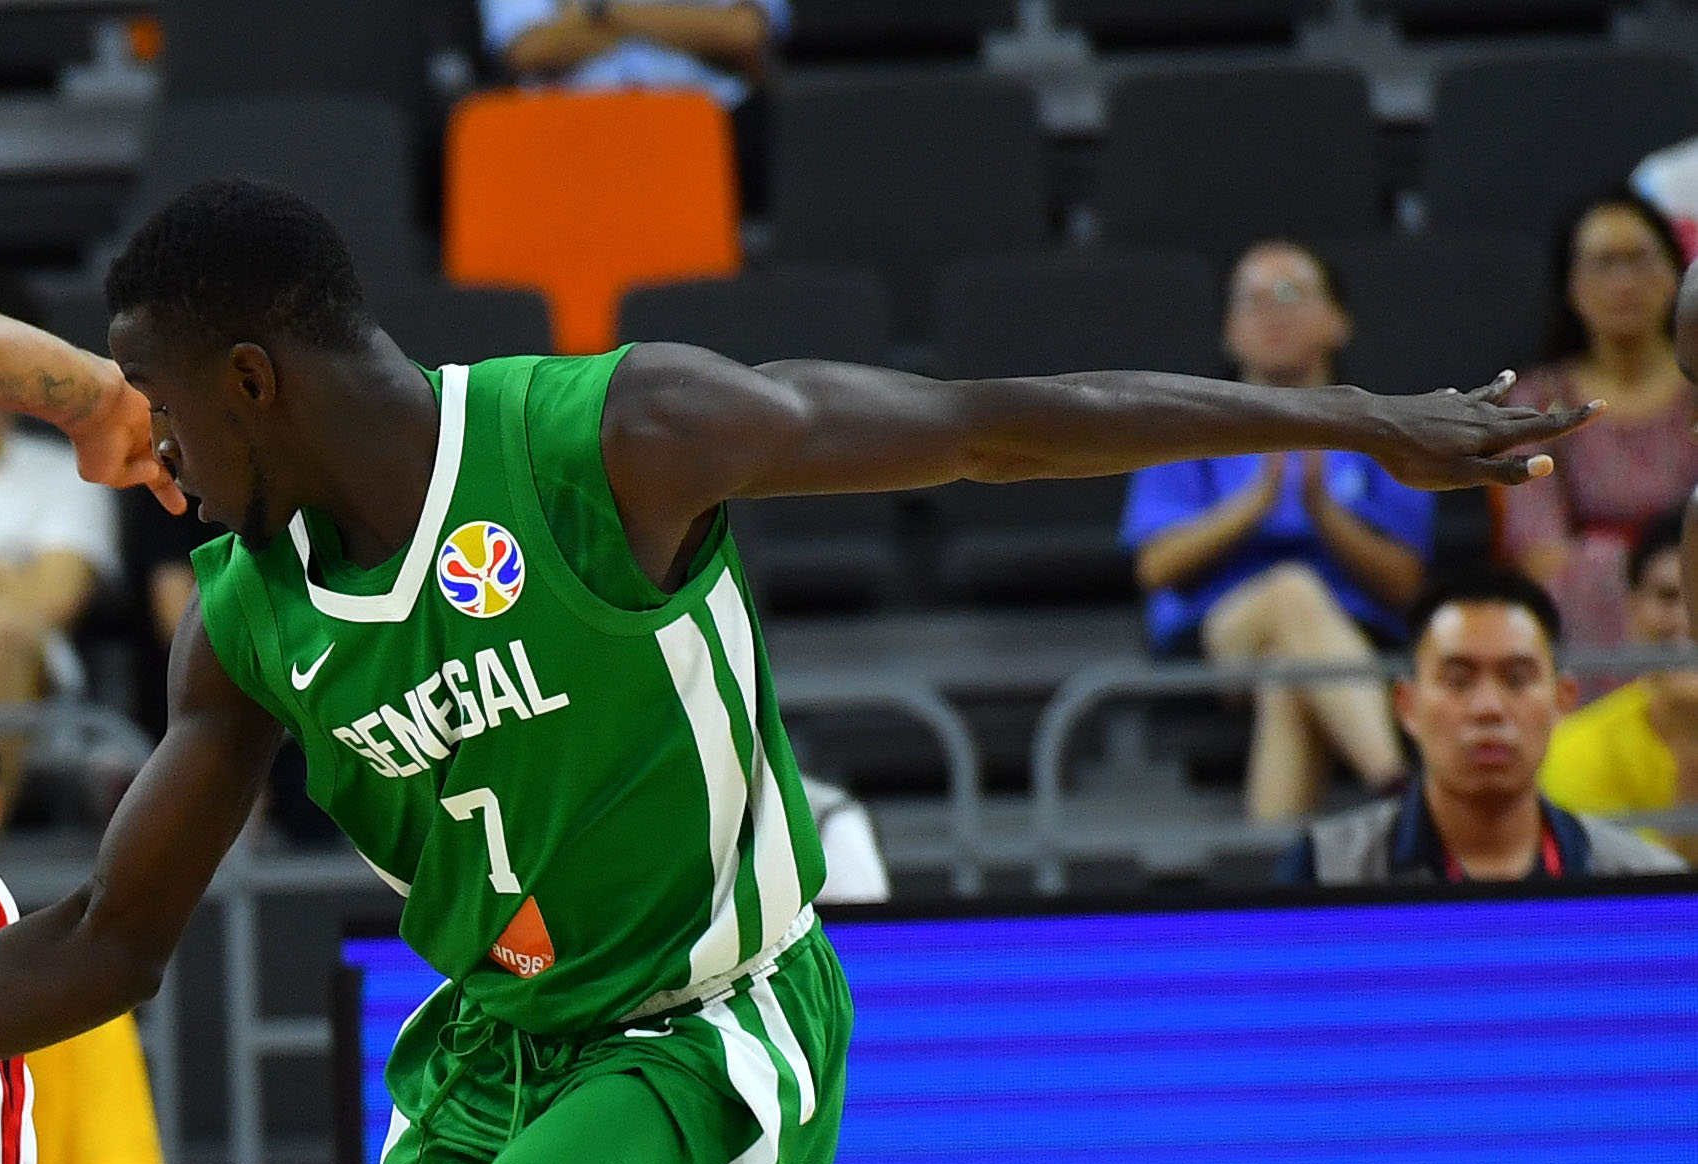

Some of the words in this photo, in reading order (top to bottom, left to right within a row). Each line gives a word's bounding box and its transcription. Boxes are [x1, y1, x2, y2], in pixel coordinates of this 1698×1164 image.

[331, 639, 570, 778] SENEGAL
[440, 787, 522, 894] 7
[492, 942, 545, 975] ange
